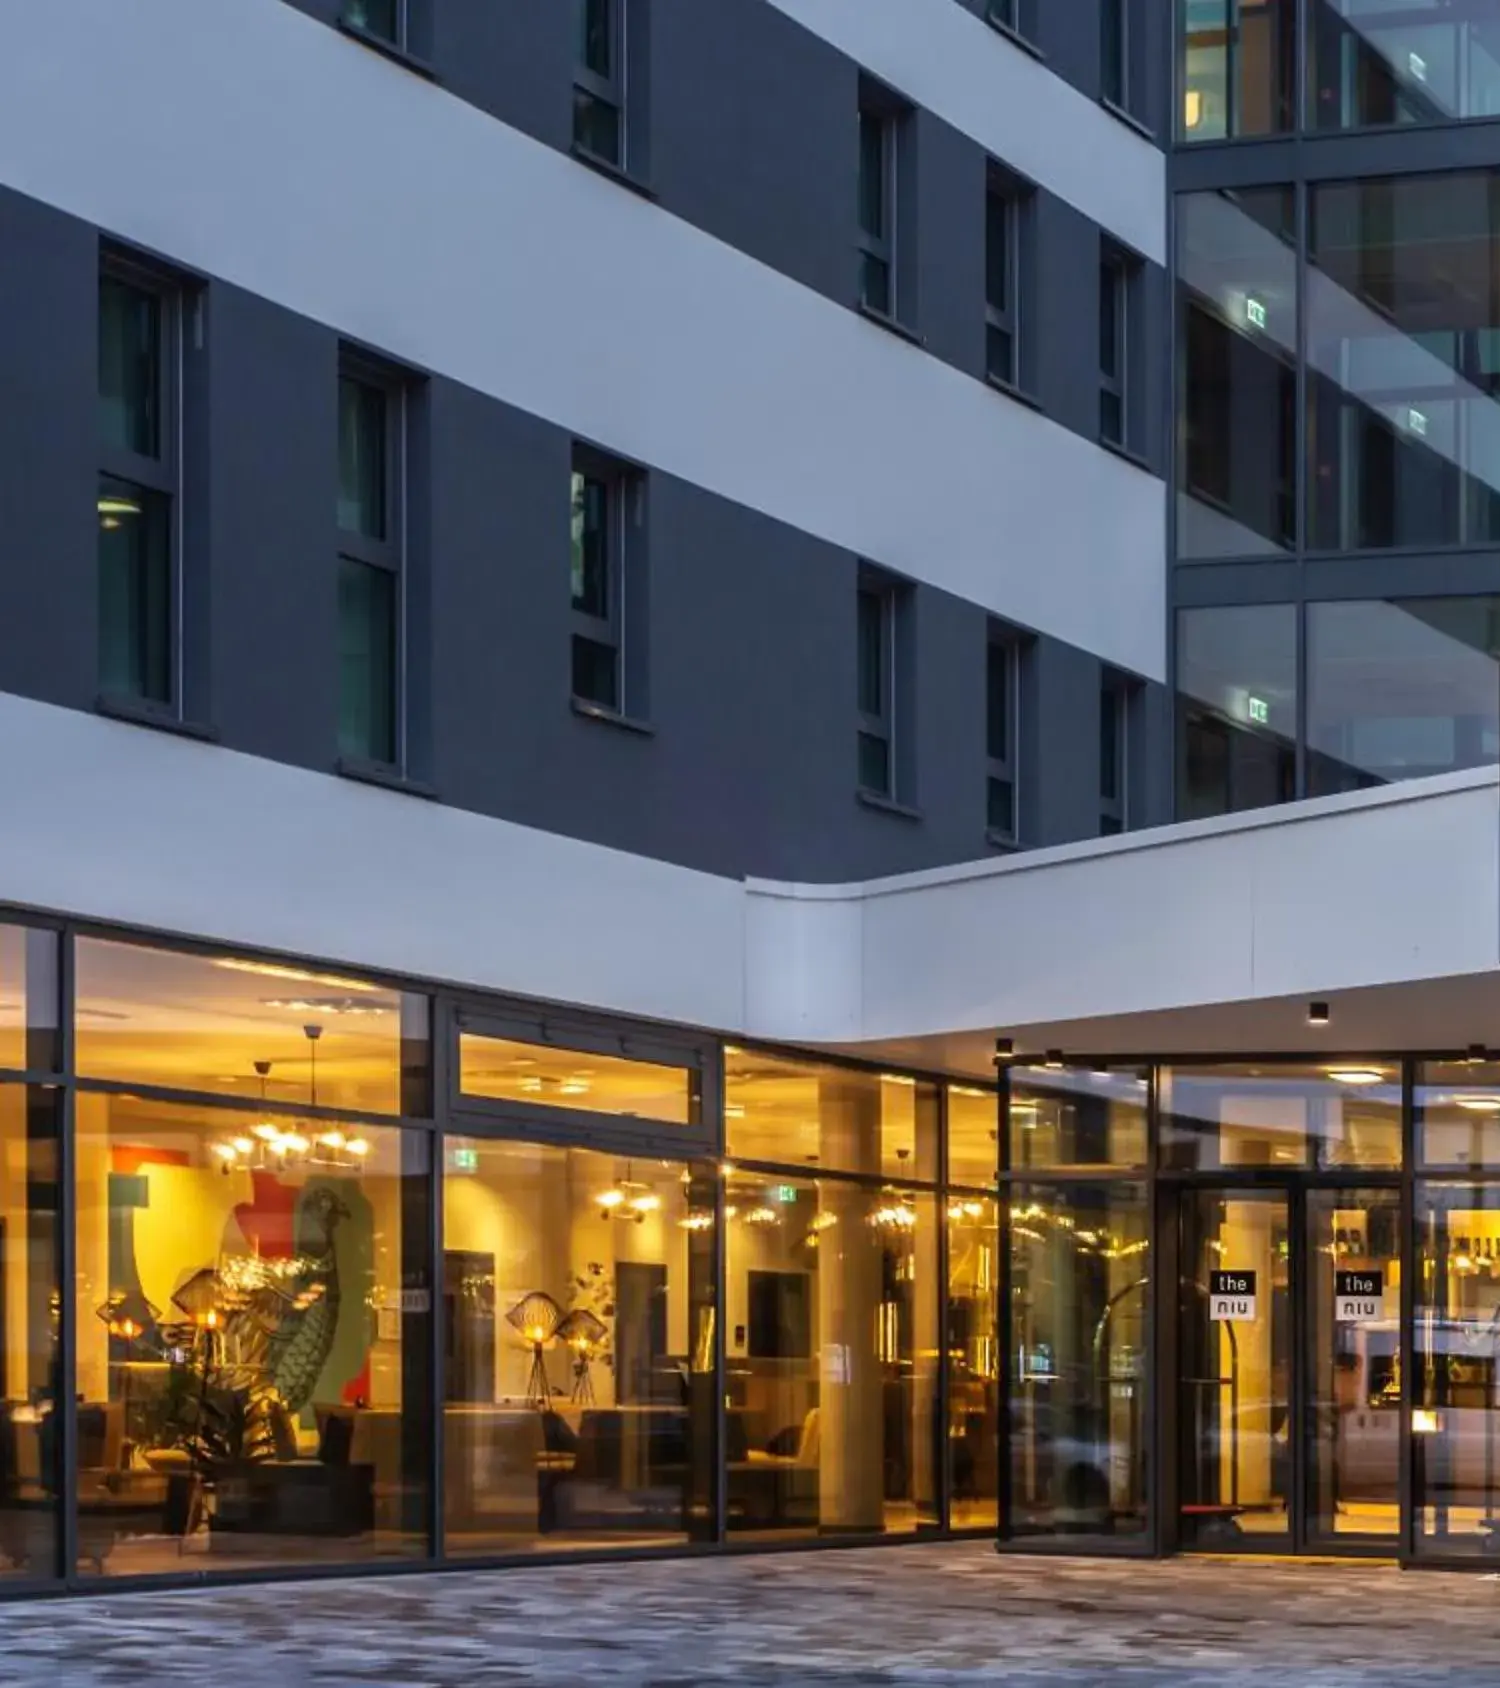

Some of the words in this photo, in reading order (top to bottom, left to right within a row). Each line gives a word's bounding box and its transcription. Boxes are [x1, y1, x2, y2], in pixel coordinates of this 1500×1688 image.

[1219, 1275, 1247, 1291] the
[1345, 1275, 1373, 1292] the
[1217, 1301, 1247, 1314] niu
[1343, 1302, 1375, 1315] niu
